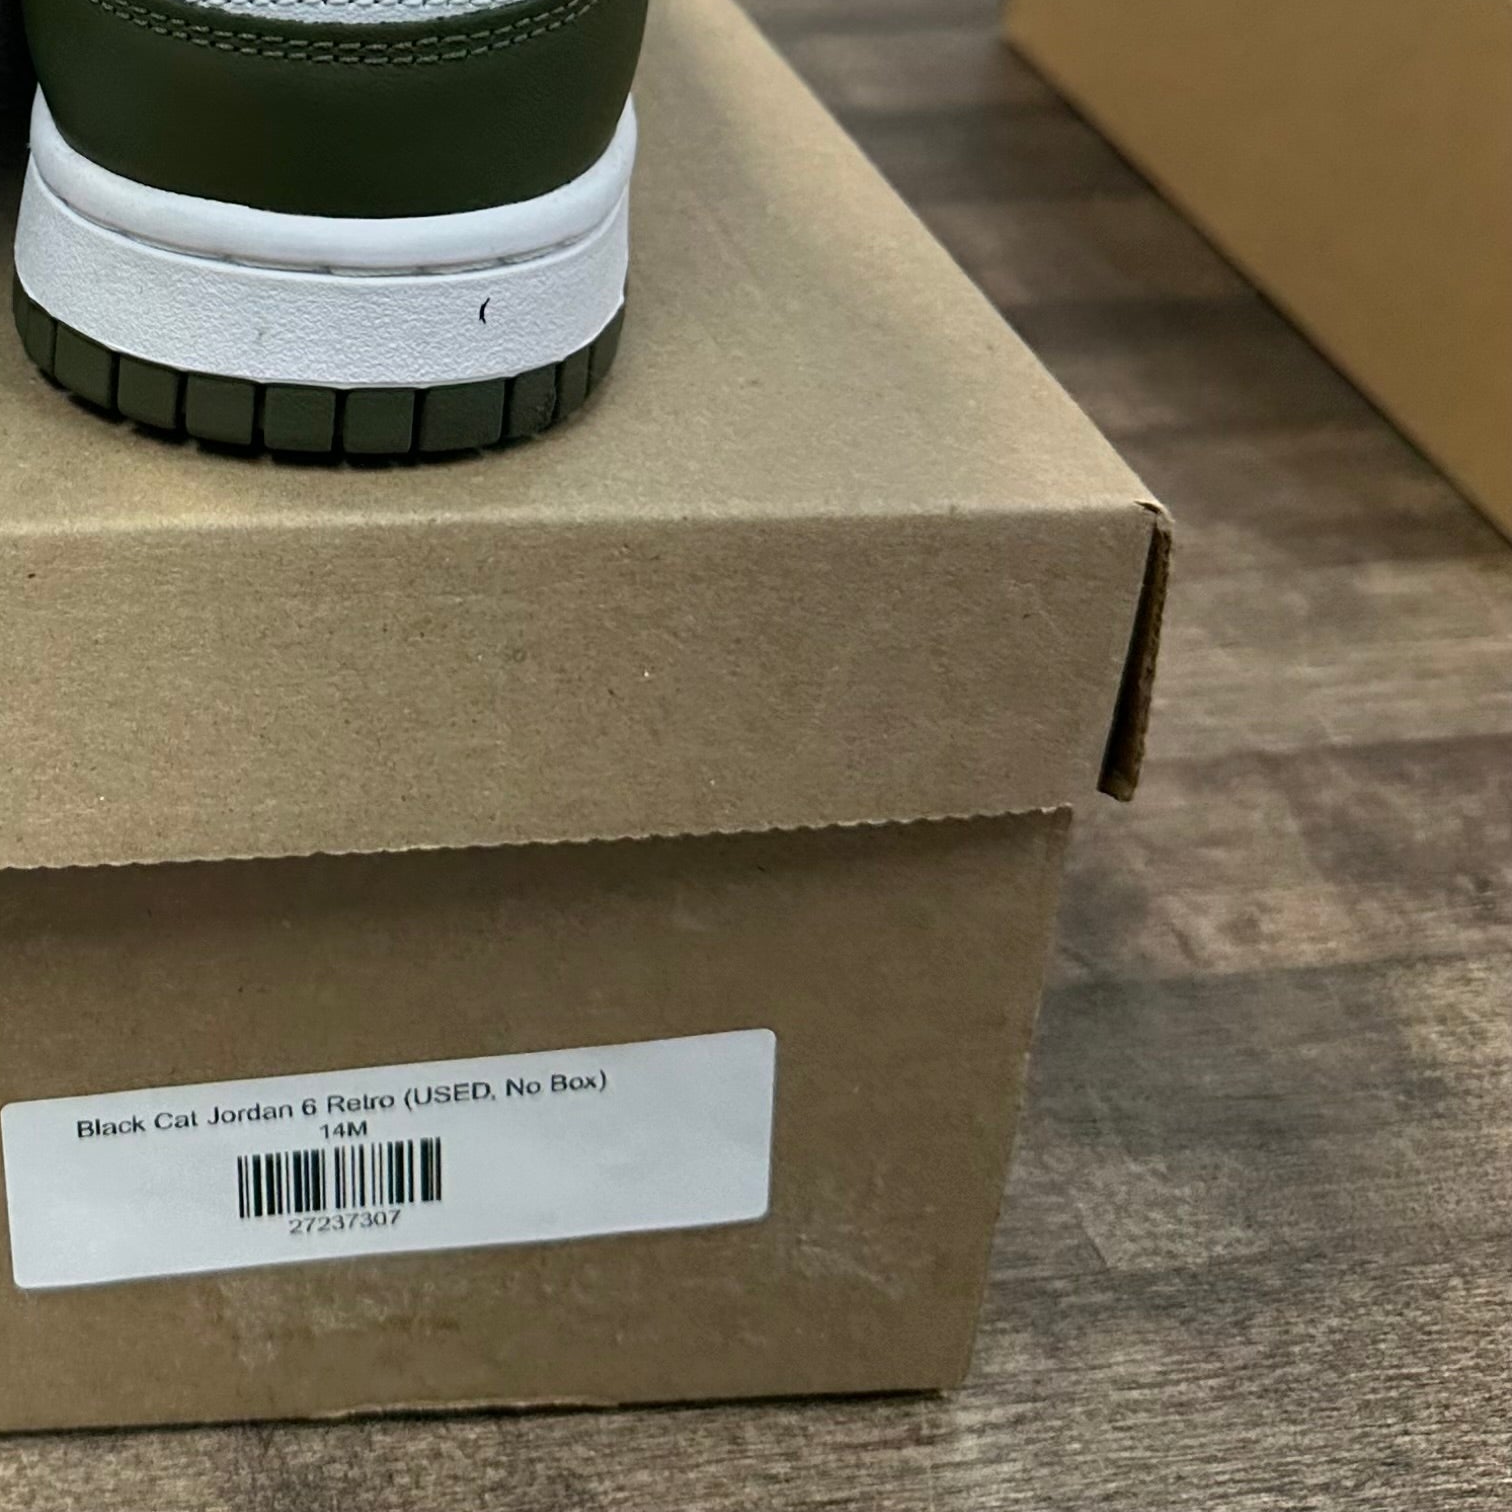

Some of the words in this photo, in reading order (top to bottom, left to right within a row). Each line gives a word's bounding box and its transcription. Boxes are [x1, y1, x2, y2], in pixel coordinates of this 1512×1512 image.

[76, 1115, 146, 1139] Black
[154, 1110, 198, 1130] Cat
[207, 1102, 293, 1125] Jordan
[301, 1097, 318, 1117] 6
[326, 1094, 396, 1114] Retro
[403, 1081, 497, 1113] (USED,
[506, 1077, 542, 1098] No
[550, 1069, 608, 1094] Box)
[319, 1120, 368, 1139] 14M
[288, 1209, 402, 1235] 27237307
